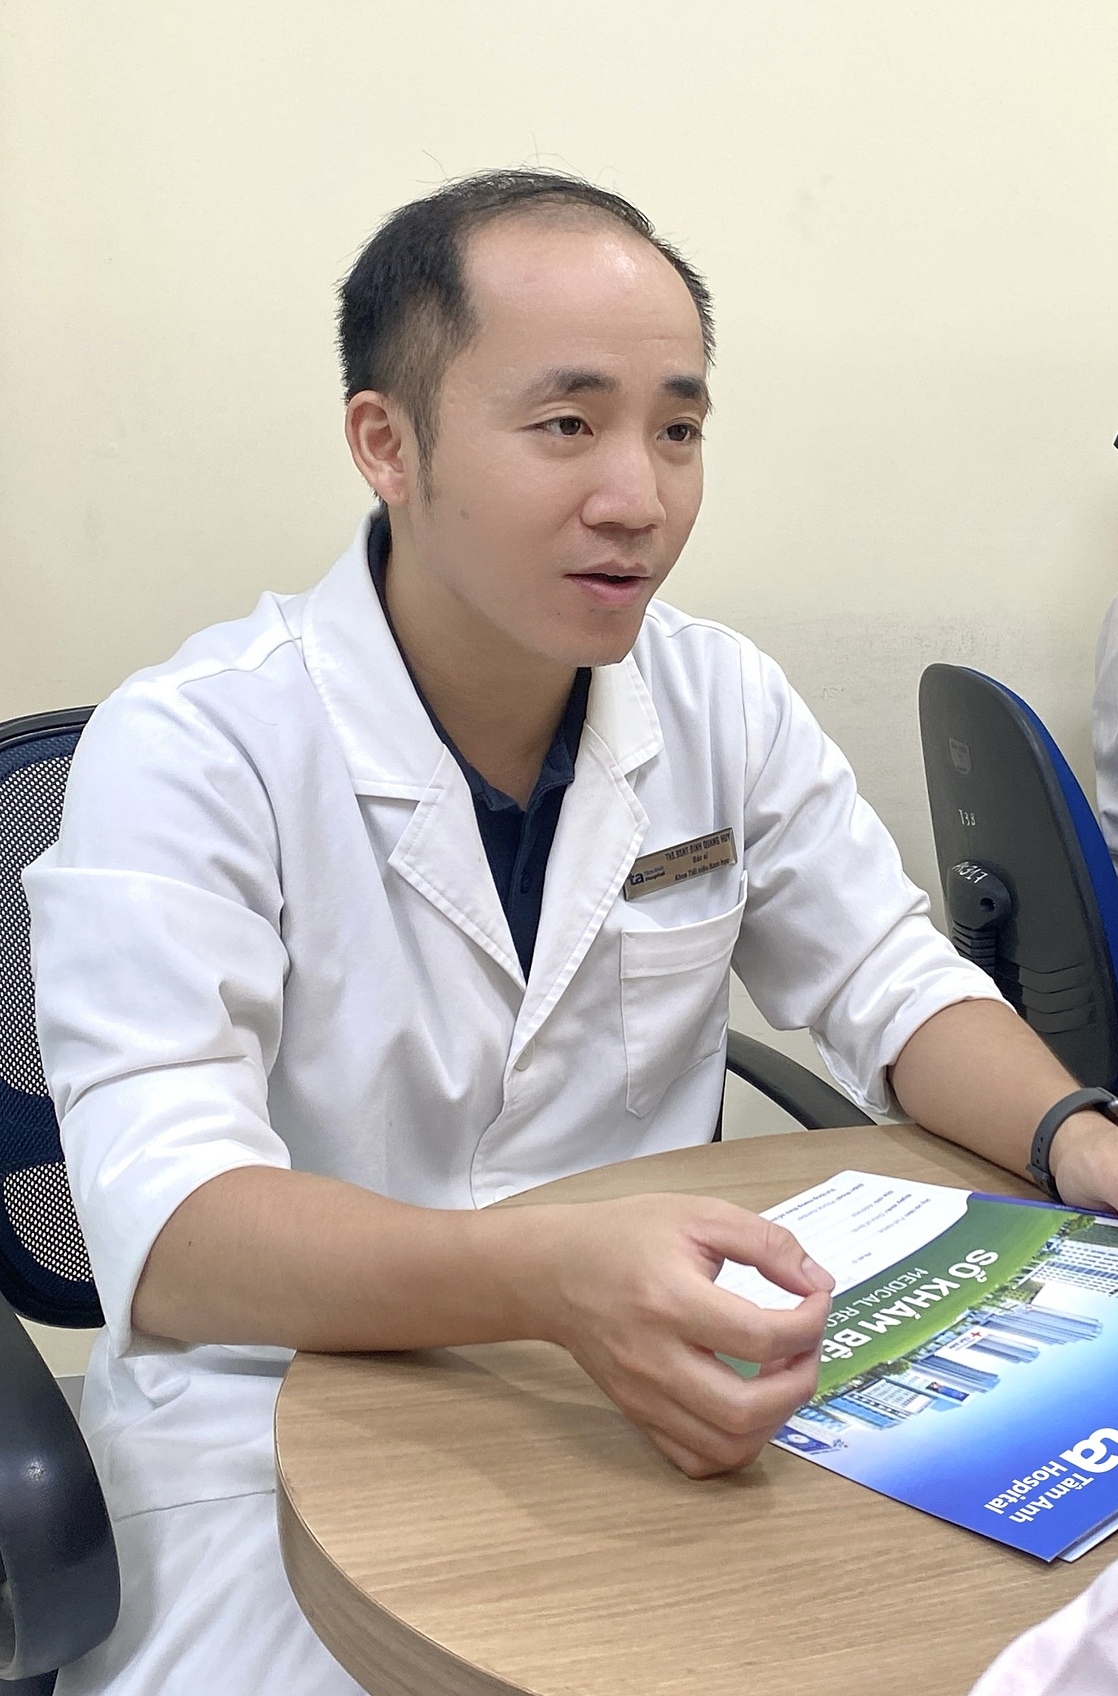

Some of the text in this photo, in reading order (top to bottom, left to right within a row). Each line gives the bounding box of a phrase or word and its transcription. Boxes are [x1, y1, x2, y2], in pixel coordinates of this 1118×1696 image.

[853, 1267, 929, 1307] MEDICAL
[948, 1249, 998, 1282] SỔ
[858, 1277, 961, 1334] KHÁM
[984, 1460, 1068, 1515] Hospital
[1008, 1472, 1094, 1523] Tâm Anh
